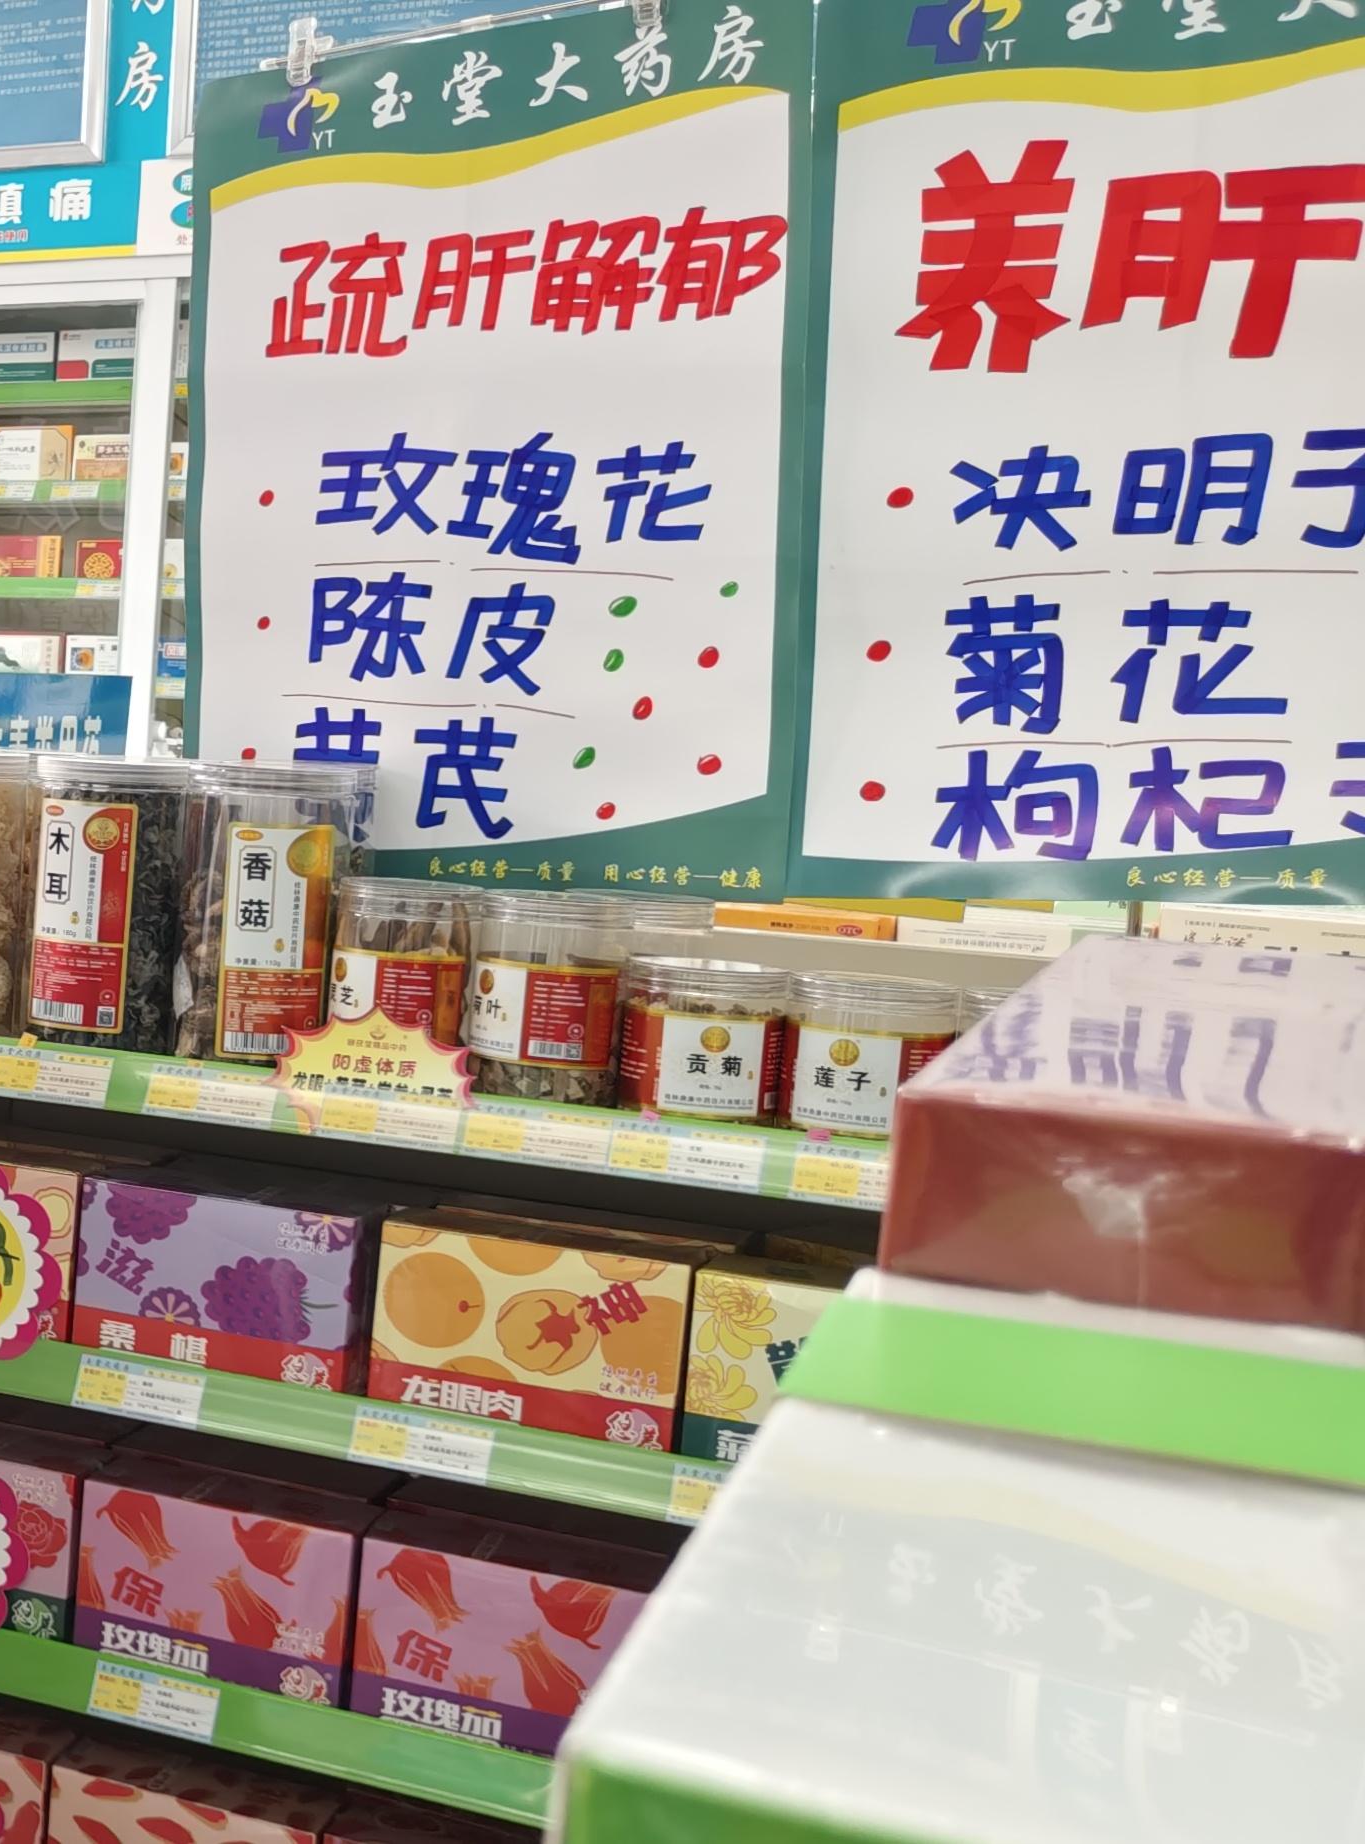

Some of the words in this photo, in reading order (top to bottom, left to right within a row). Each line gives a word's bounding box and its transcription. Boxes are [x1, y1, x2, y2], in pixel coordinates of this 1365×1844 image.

[371, 5, 764, 129] 玉堂大药房
[984, 38, 1016, 62] YT
[312, 129, 333, 149] YT
[266, 206, 788, 358] 疏肝解郁
[895, 139, 1365, 373] 养肝
[315, 431, 712, 564] 玫瑰花
[308, 572, 555, 695] 陈皮
[945, 593, 1288, 735] 菊花
[45, 827, 69, 900] 木耳
[240, 852, 272, 928] 香菇
[836, 924, 863, 937] OTC
[332, 1053, 417, 1079] 阳虚体质
[686, 1053, 742, 1077] 贡菊
[814, 1066, 872, 1092] 莲子
[96, 1238, 154, 1296] 滋
[577, 1282, 648, 1335] 神
[401, 1375, 522, 1421] 龙眼肉
[110, 1566, 165, 1617] 保
[393, 1630, 452, 1682] 保
